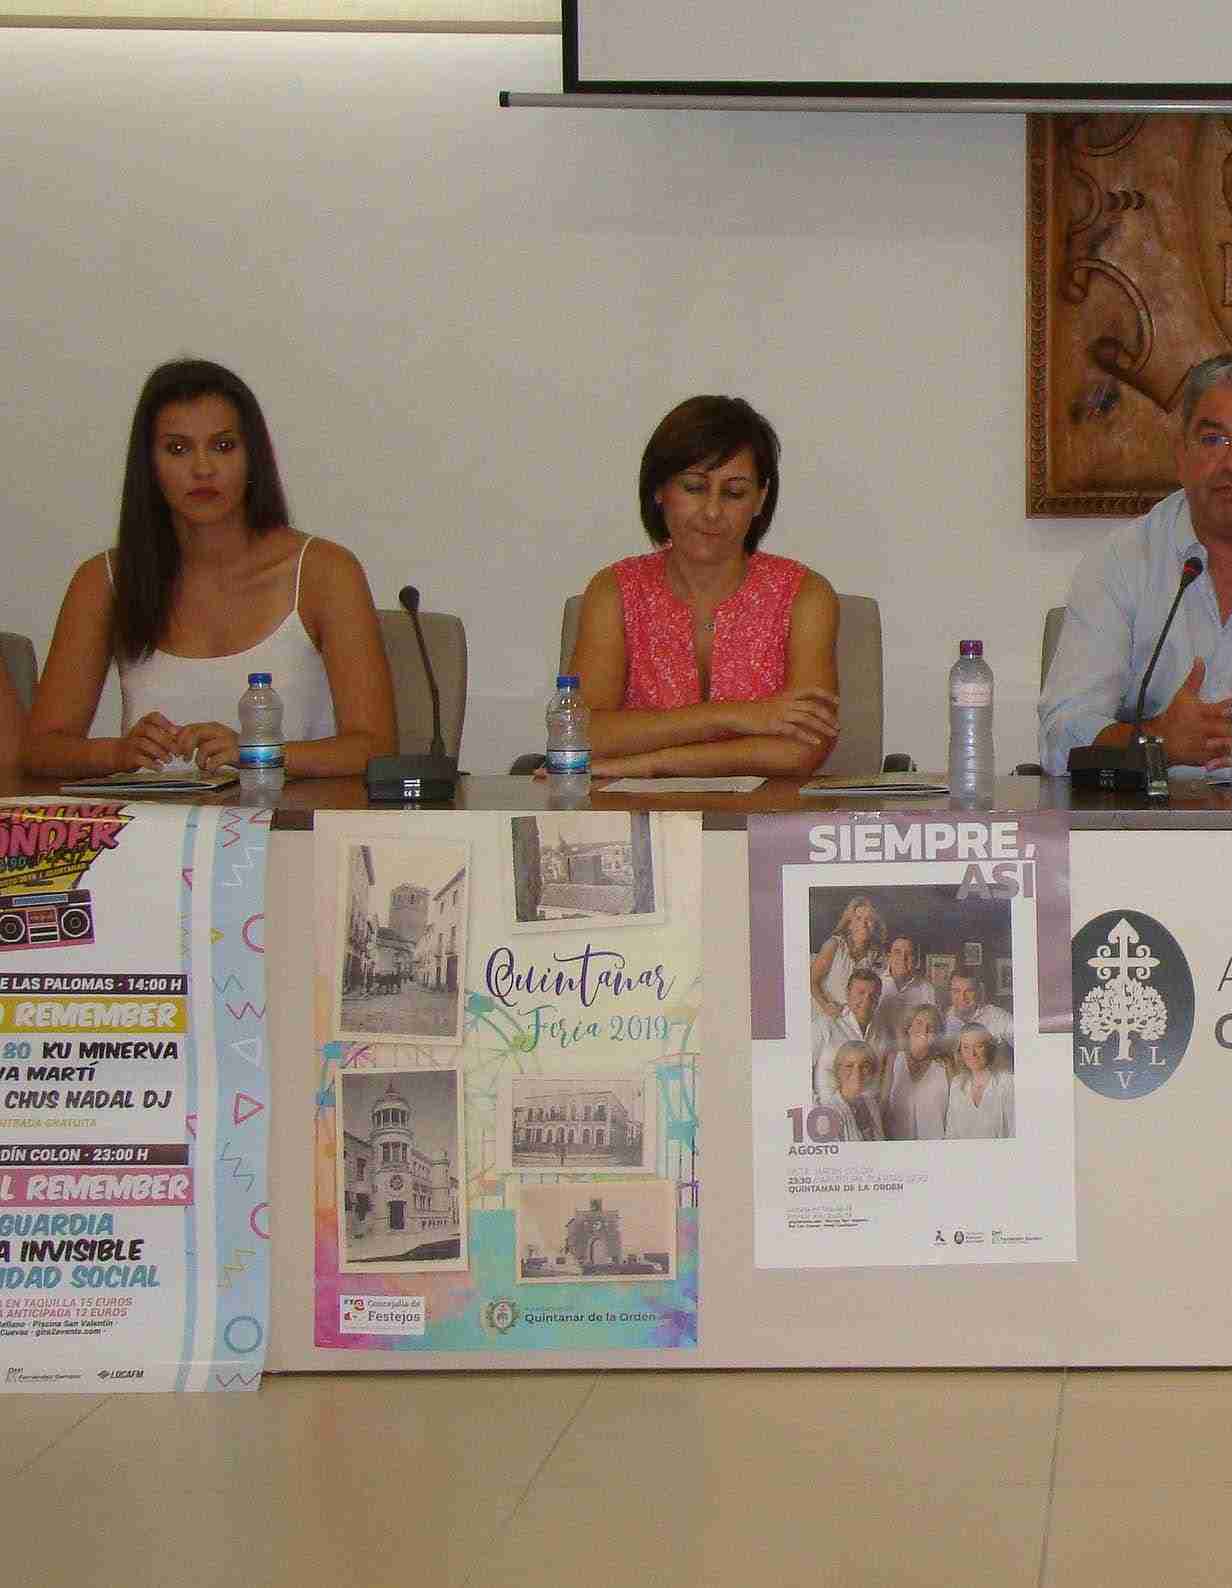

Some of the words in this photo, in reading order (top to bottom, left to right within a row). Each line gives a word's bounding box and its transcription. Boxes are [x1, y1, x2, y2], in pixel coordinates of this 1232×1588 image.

[808, 822, 1019, 862] SIEMPRE
[12, 976, 41, 991] LAS
[43, 976, 115, 991] PALOMAS
[127, 977, 167, 991] 14:00
[169, 978, 182, 991] H
[485, 943, 677, 1007] Quintanar
[16, 1001, 178, 1028] REMEMBER
[517, 1004, 601, 1052] Feria
[608, 1014, 672, 1042] 2019
[2, 1041, 31, 1059] 80
[41, 1041, 73, 1059] KU
[79, 1041, 179, 1060] MINERVA
[1079, 1046, 1102, 1066] M
[1148, 1046, 1167, 1066] L
[26, 1061, 99, 1081] MARTÍ
[1114, 1071, 1134, 1089] V
[4, 1089, 60, 1109] CHUS
[65, 1089, 135, 1109] NADAL
[143, 1089, 173, 1109] DJ
[784, 1104, 843, 1144] 10
[30, 1148, 80, 1162] COLON
[92, 1148, 134, 1161] 23:00
[136, 1148, 149, 1161] H
[788, 1145, 840, 1157] AGOSTO
[26, 1174, 191, 1201] REMEMBER
[20, 1239, 145, 1263] INVISIBLE
[69, 1265, 161, 1289] SOCIAL
[95, 1296, 133, 1307] EUROS
[90, 1307, 129, 1317] EUROS
[368, 1310, 421, 1325] Festejos
[525, 1312, 585, 1323] Quintanar
[588, 1312, 603, 1322] de
[605, 1311, 617, 1322] la
[619, 1311, 657, 1322] Orden
